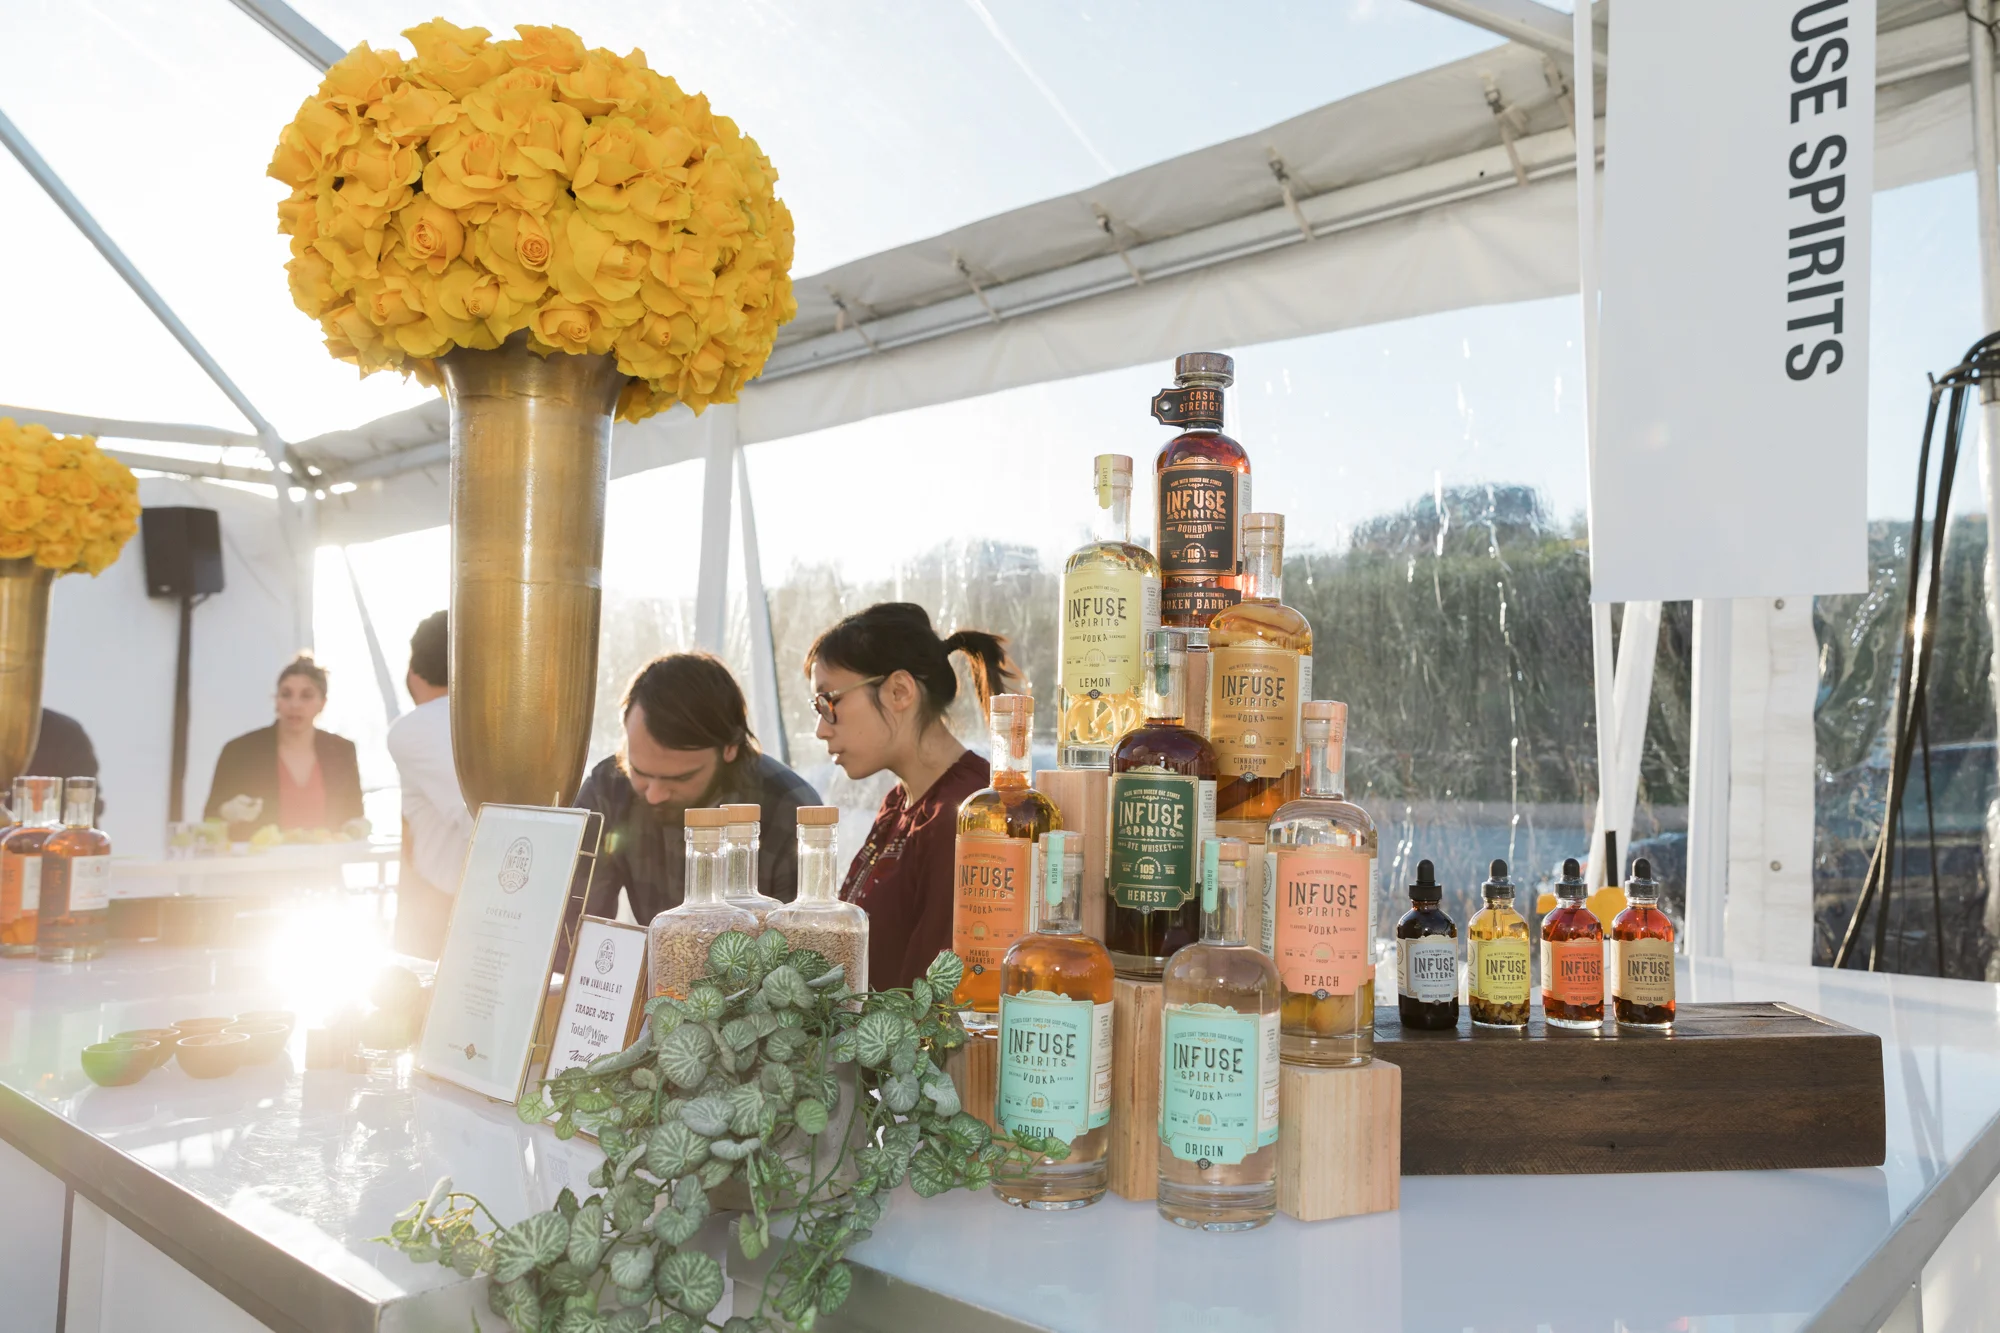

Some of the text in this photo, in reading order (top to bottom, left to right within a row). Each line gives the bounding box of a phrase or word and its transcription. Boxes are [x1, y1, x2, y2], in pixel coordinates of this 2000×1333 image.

[1786, 135, 1847, 381] SPIRITS
[1189, 391, 1215, 400] CASK
[1166, 489, 1227, 515] INFUSE
[1173, 509, 1219, 520] SPIRITS
[1177, 524, 1213, 533] BOURBON
[1187, 548, 1200, 558] 116
[1068, 597, 1127, 622] INFUSE
[1075, 617, 1120, 627] SPIRITS
[1082, 633, 1108, 642] VODKA
[1079, 677, 1111, 688] LEMON
[1221, 675, 1286, 702] INFUSE
[1229, 697, 1278, 707] SPIRITS
[1237, 712, 1265, 723] VODKA
[1233, 757, 1267, 765] CINNAMON
[1119, 801, 1184, 830] INFUSE
[1125, 825, 1177, 838] SPIRITS
[1127, 841, 1139, 851] RYE
[1141, 843, 1172, 853] WHISKEY
[1140, 863, 1155, 875] 105
[959, 865, 1015, 892] INFUSE
[963, 888, 1006, 899] SPIRITS
[1127, 889, 1167, 903] HERESY
[1288, 881, 1358, 910] INFUSE
[969, 904, 993, 914] VODKA
[1297, 907, 1351, 917] SPIRITS
[1308, 923, 1338, 935] VODKA
[969, 949, 990, 957] MANGO
[965, 956, 995, 964] HABANERO
[1414, 956, 1455, 974] INFUSE
[1485, 959, 1527, 976] INFUSE
[1561, 960, 1601, 977] INFUSE
[1627, 960, 1670, 977] INFUSE
[580, 976, 623, 995] NOW AVAILABLE AT
[1304, 974, 1339, 987] PEACH
[575, 1003, 615, 1022] TRADER JOE'S
[570, 1022, 609, 1043] Total Wine
[1008, 1027, 1077, 1059] INFUSE
[1015, 1054, 1067, 1067] SPIRITS
[1173, 1042, 1244, 1074] INFUSE
[1023, 1072, 1056, 1085] VODKA
[1180, 1070, 1235, 1083] SPIRITS
[1189, 1088, 1223, 1101] VODKA
[1017, 1123, 1055, 1138] ORIGIN
[1185, 1142, 1224, 1157] ORIGIN
